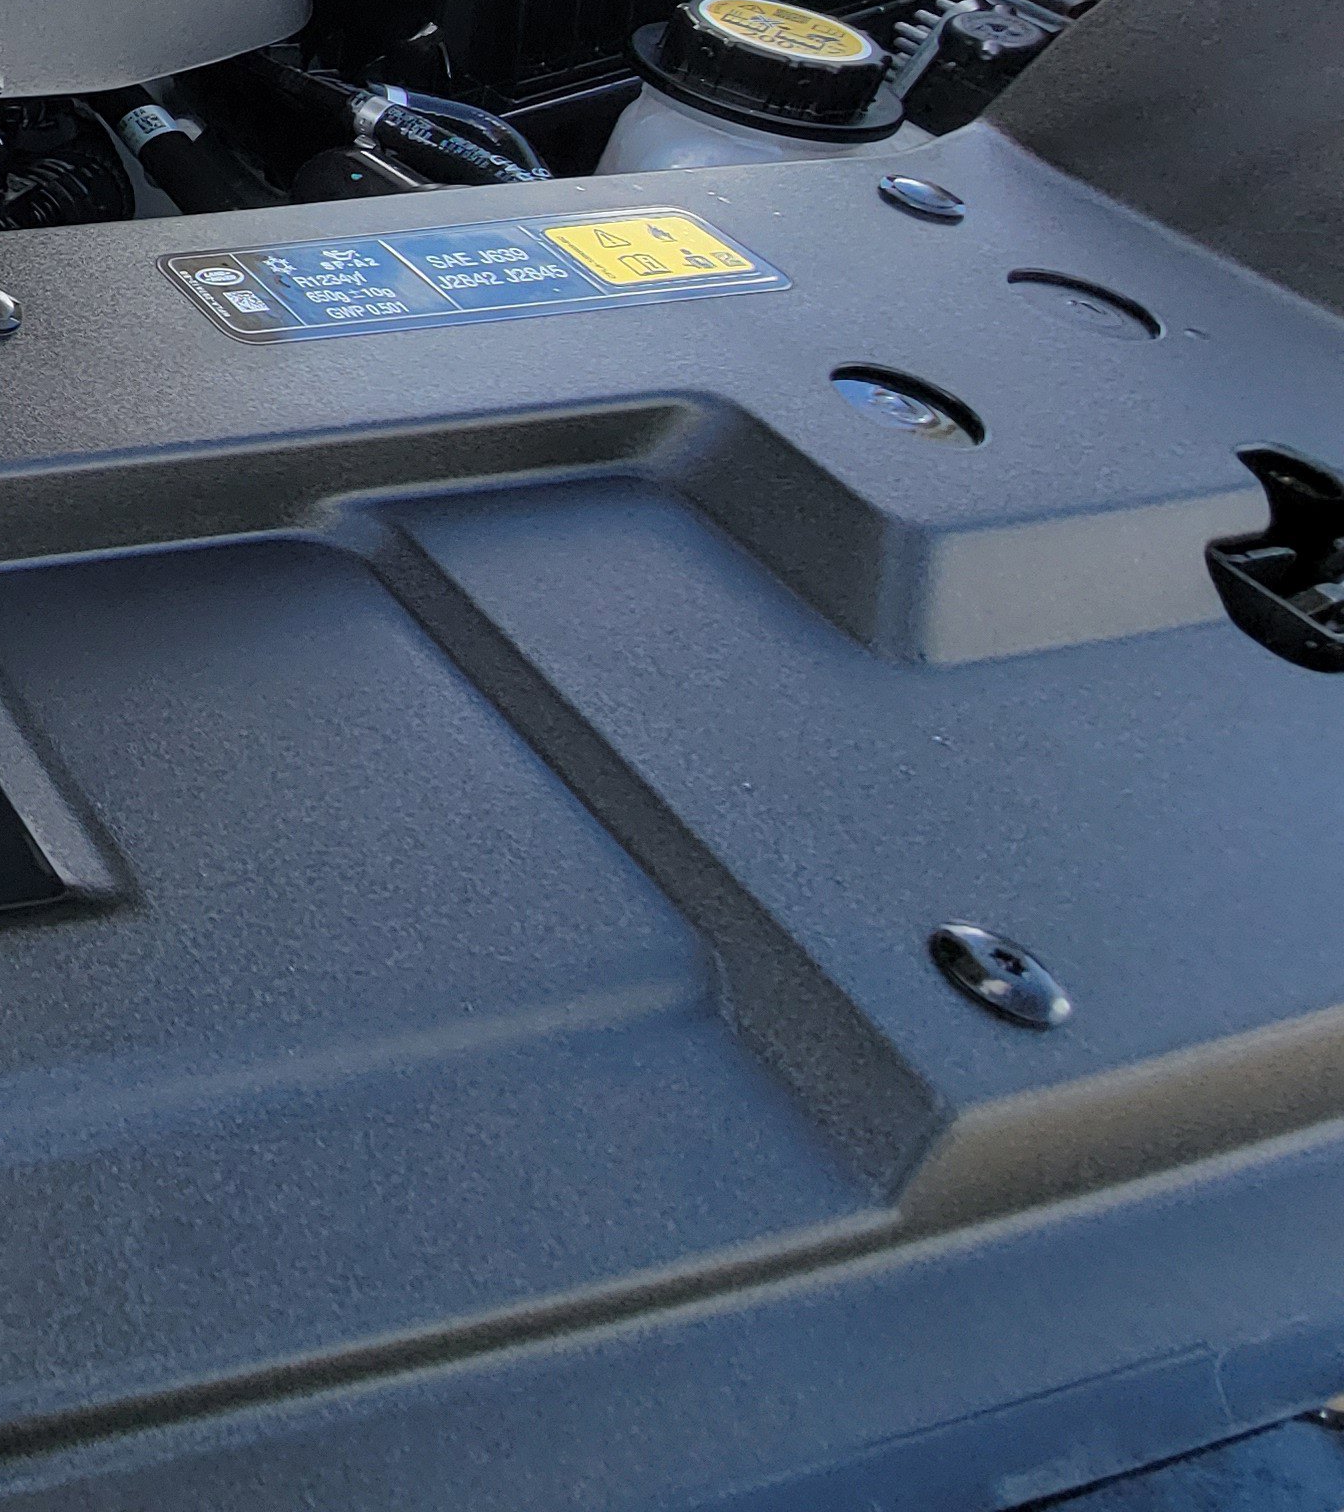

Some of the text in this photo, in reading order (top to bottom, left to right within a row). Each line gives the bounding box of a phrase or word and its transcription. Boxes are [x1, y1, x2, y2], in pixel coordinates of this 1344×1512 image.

[425, 247, 531, 270] SAE J639
[292, 270, 368, 289] R1234yf
[437, 264, 569, 290] J2842 J2845
[305, 289, 353, 304] 650g
[326, 301, 410, 320] GWP 0.501
